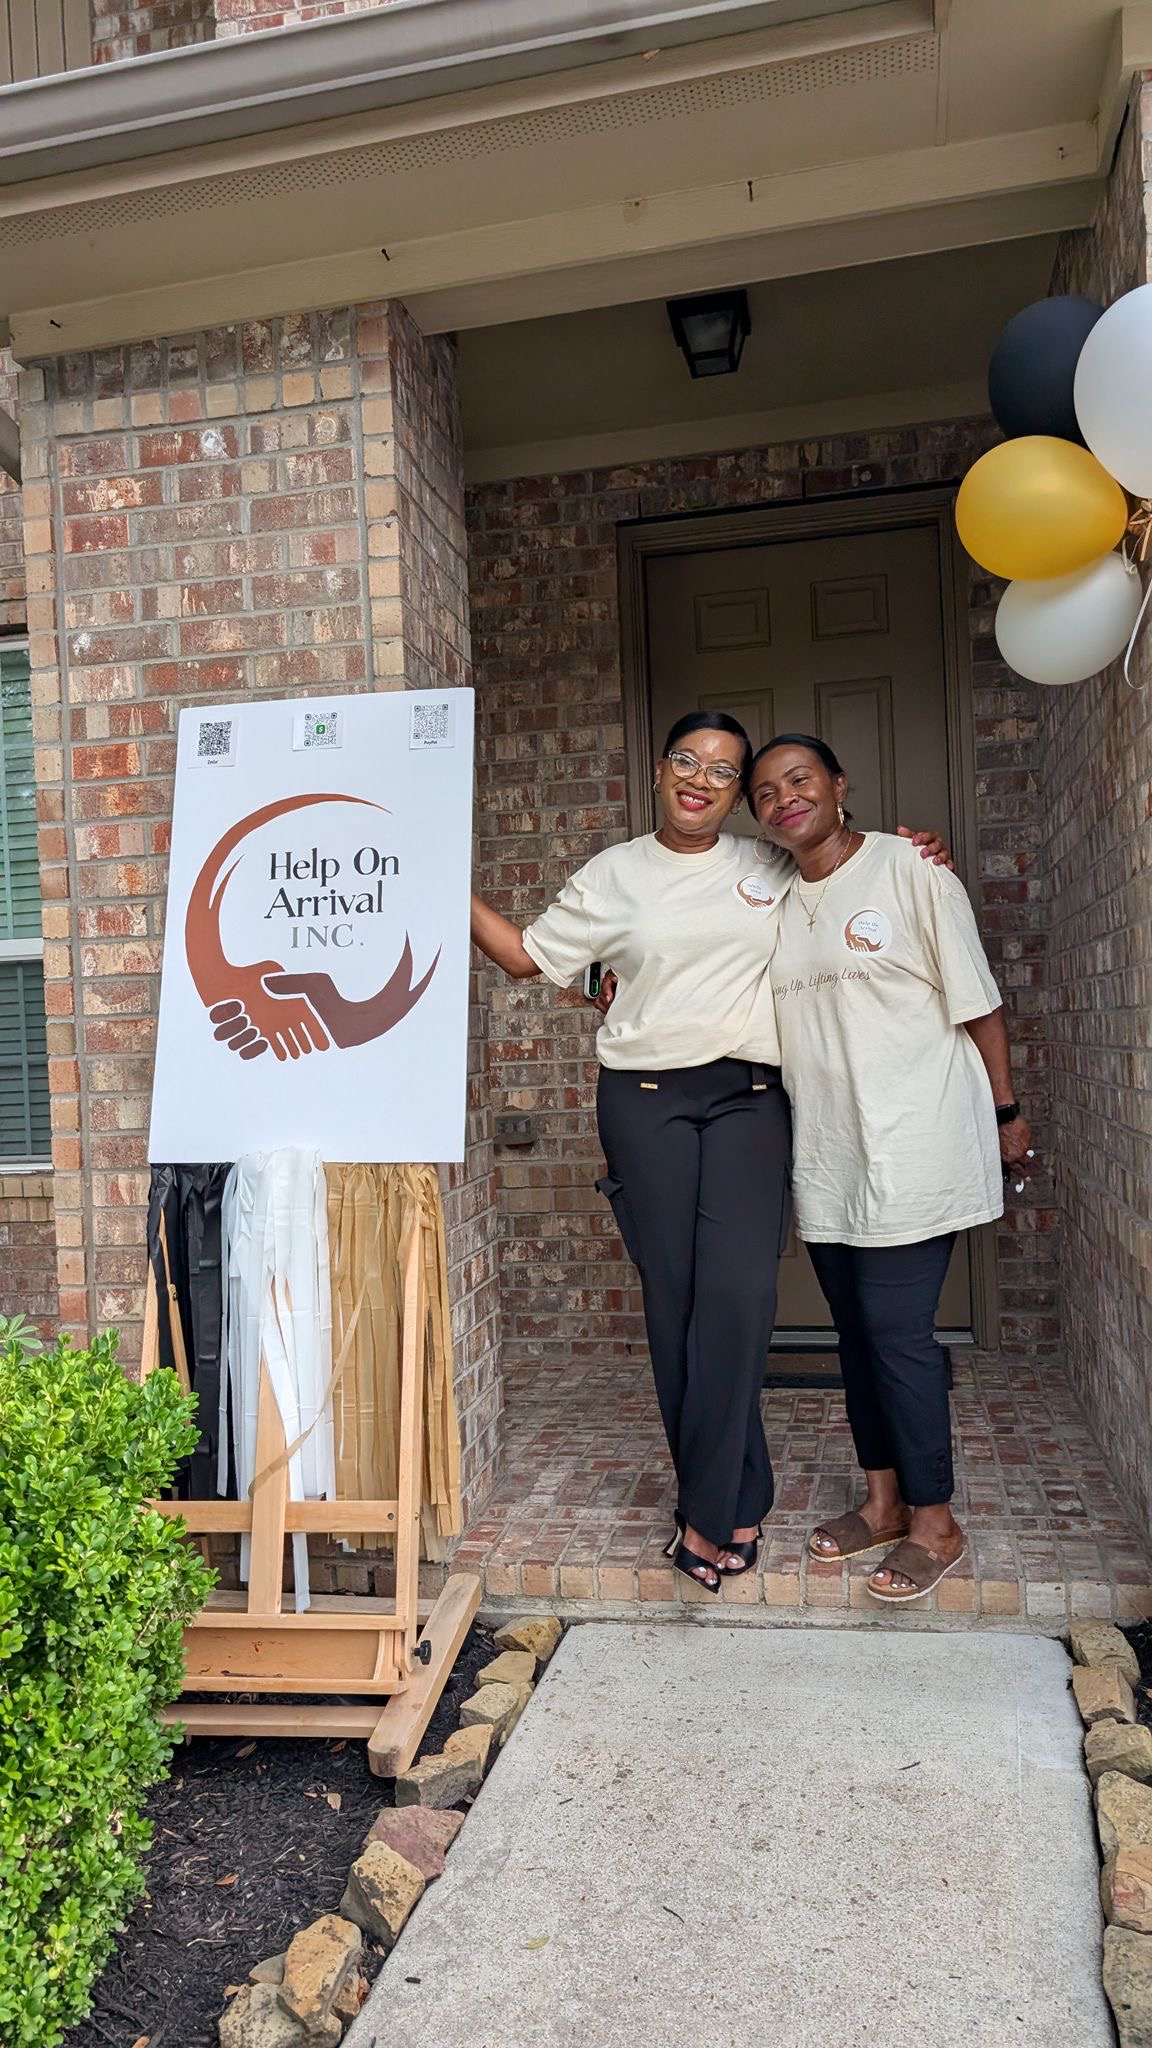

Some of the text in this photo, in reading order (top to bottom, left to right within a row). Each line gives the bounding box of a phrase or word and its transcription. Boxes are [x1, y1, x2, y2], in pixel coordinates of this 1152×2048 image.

[269, 846, 401, 887] Help On
[263, 880, 384, 919] Arrival
[290, 923, 364, 949] INC.
[774, 984, 788, 1000] ing
[808, 971, 839, 992] Lifting
[841, 967, 871, 981] Lives
